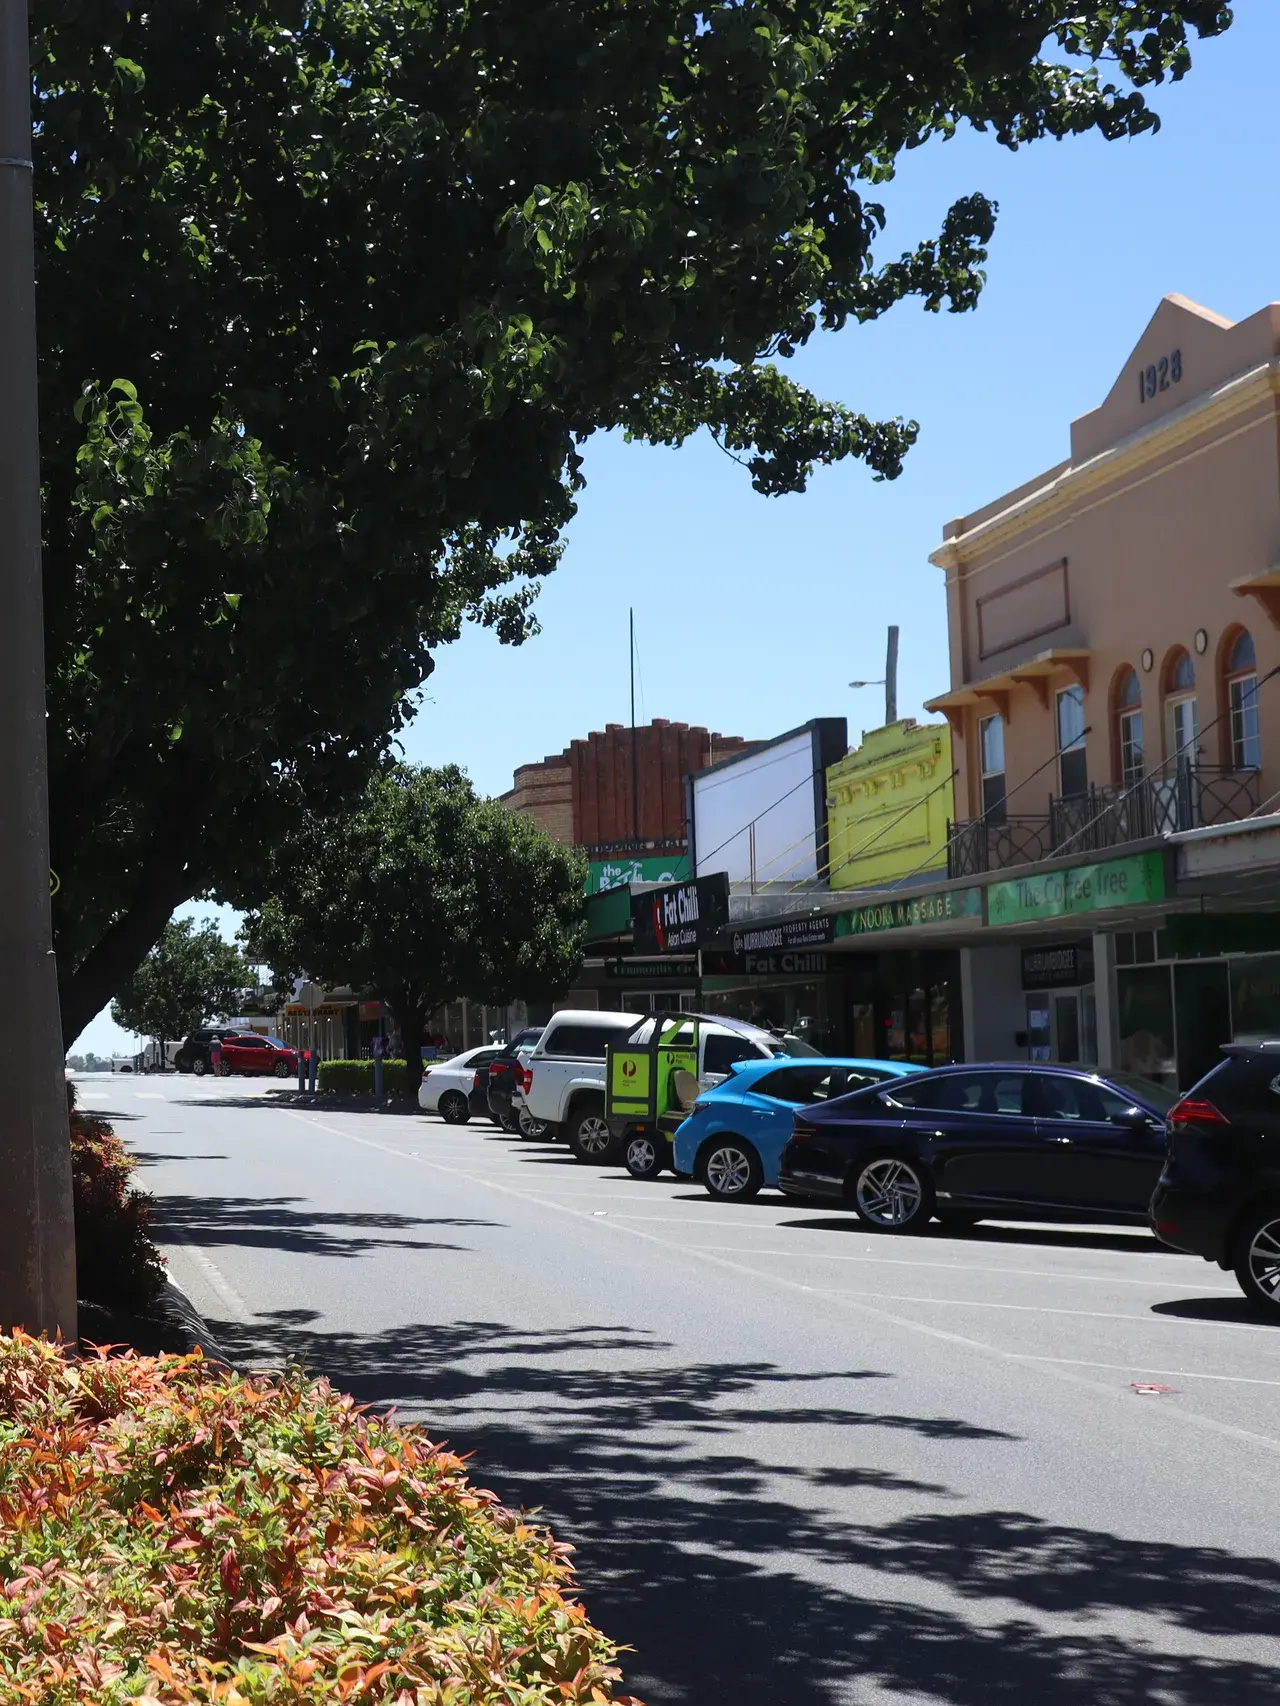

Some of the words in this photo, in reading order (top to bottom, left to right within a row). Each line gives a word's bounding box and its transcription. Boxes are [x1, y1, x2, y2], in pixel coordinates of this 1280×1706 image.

[1138, 348, 1183, 404] 1928
[603, 864, 622, 877] the
[1016, 882, 1040, 909] The
[1044, 870, 1092, 910] Coffee
[1095, 867, 1128, 896] Tree
[663, 893, 678, 927] Fat
[677, 886, 700, 924] Chilli
[860, 906, 894, 930] NOORA
[897, 898, 952, 922] MASSAGE
[809, 918, 830, 930] AGENTS
[667, 932, 680, 947] Asian
[680, 929, 697, 945] Cuisine
[746, 954, 776, 973] Fat
[781, 953, 827, 972] Chilli
